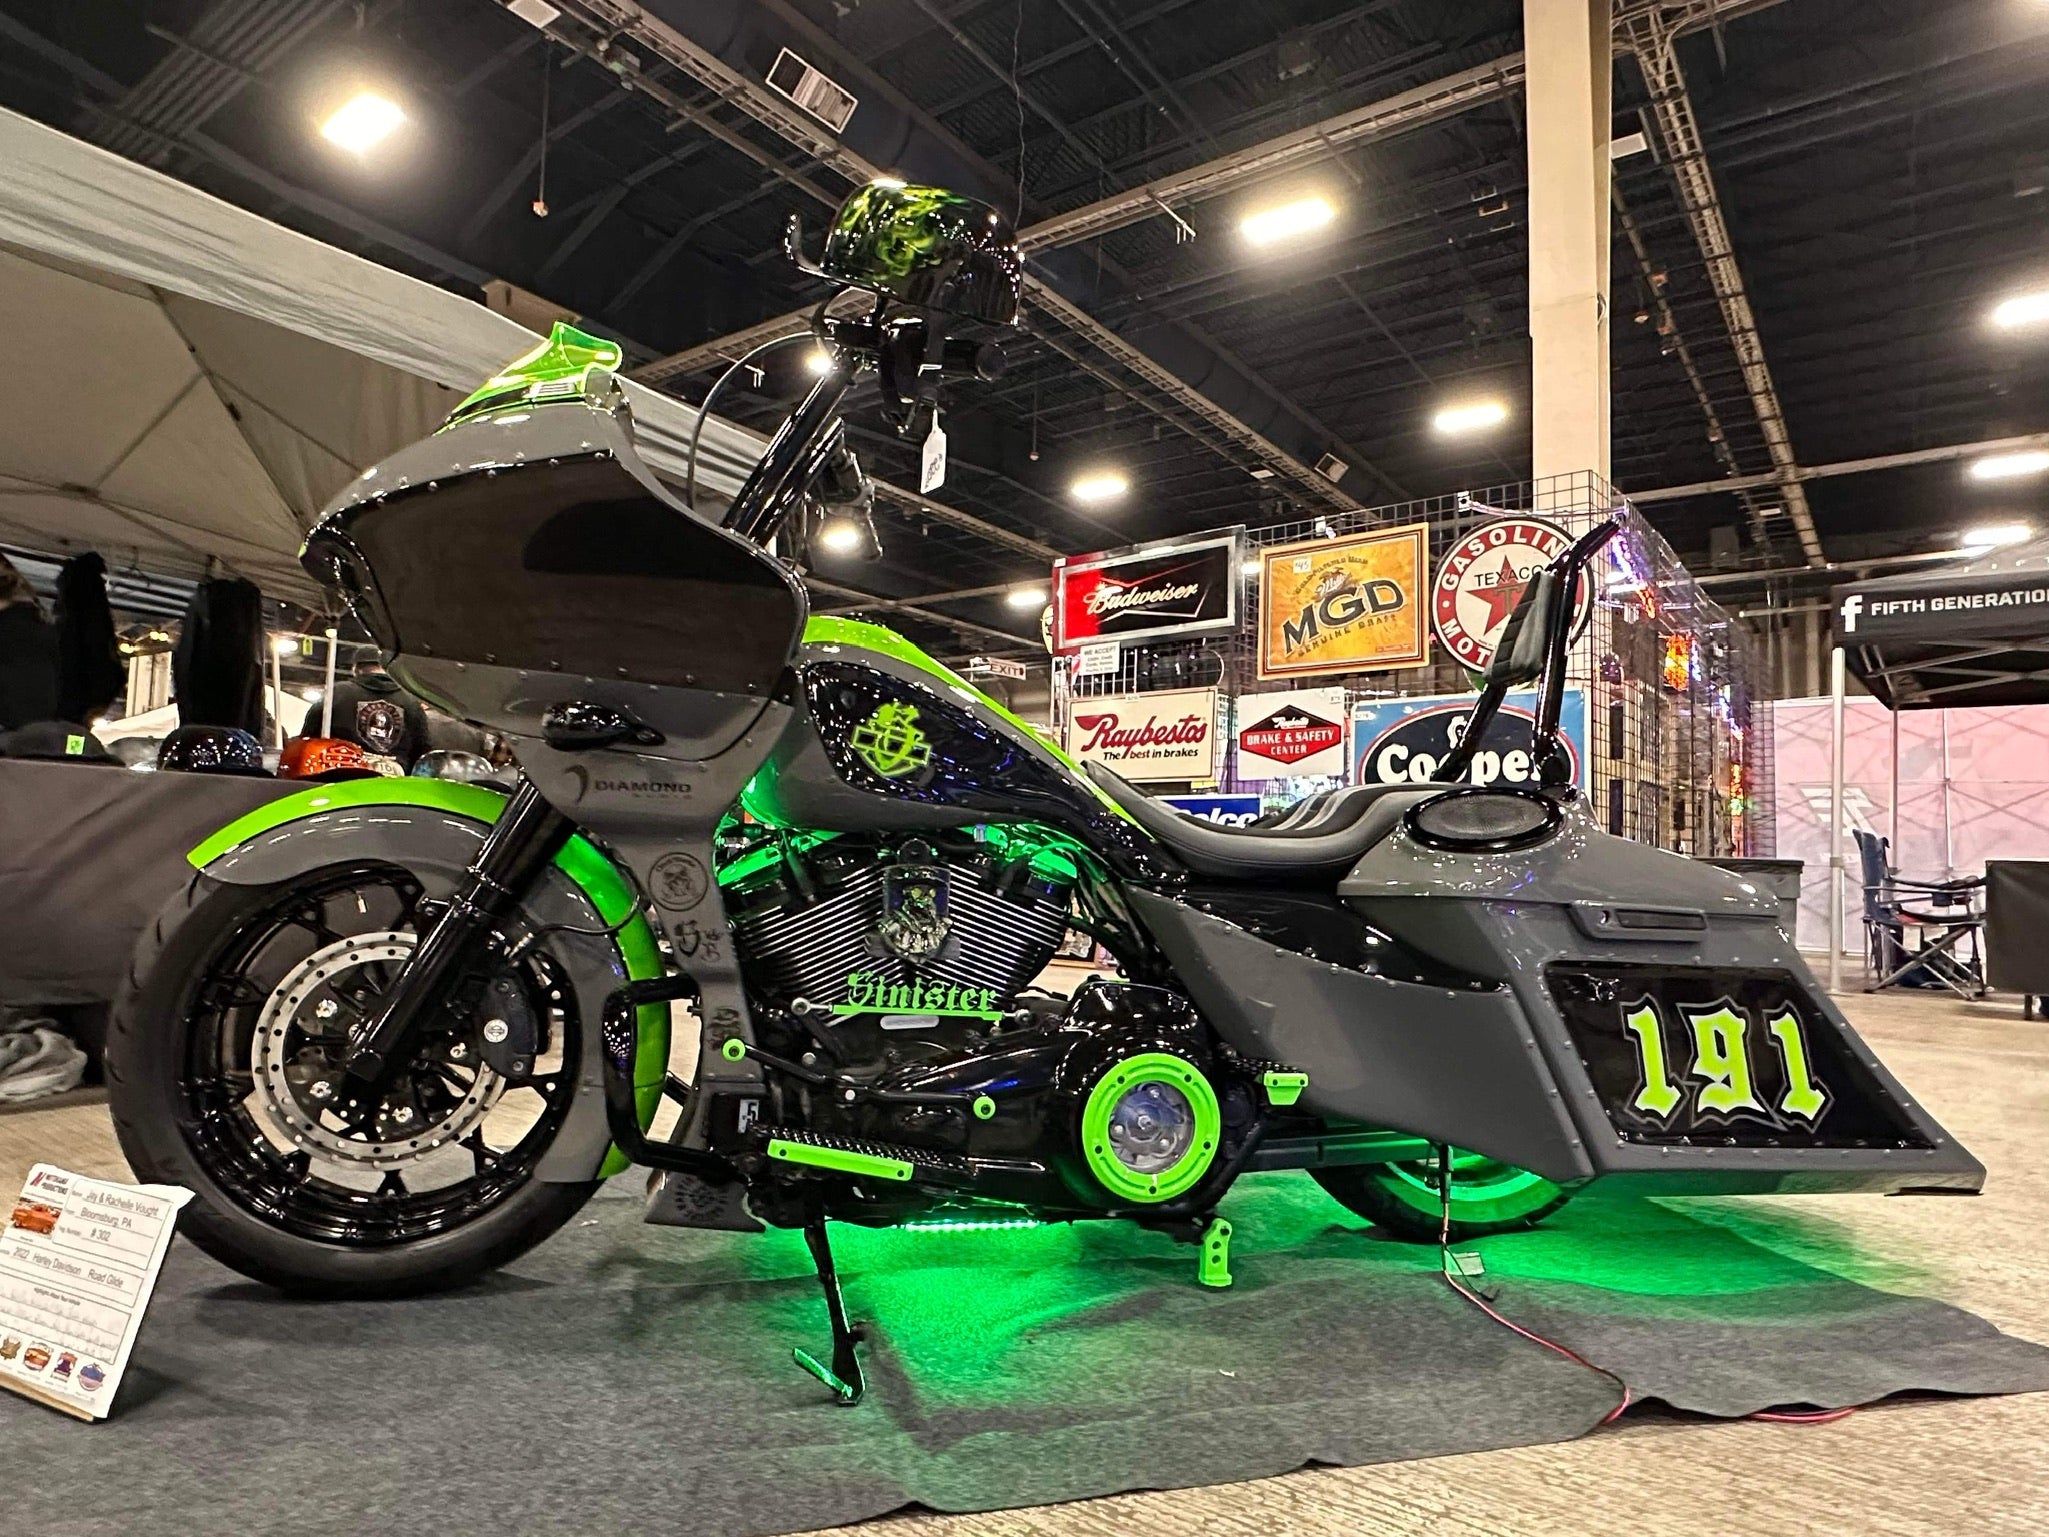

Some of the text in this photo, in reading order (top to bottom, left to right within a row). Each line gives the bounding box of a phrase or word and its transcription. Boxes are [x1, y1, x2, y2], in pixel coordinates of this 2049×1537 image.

[1441, 526, 1566, 591] GASOLIN
[1083, 583, 1199, 616] Budweiser
[1871, 599, 1925, 616] FIFTH
[1282, 579, 1404, 654] MGD
[991, 663, 1019, 676] EXIT
[1074, 713, 1208, 759] Raybestos
[1246, 729, 1334, 746] BRAKE & SAFETY
[1270, 744, 1307, 755] CENTER
[1103, 747, 1199, 761] The best in brakes
[1376, 743, 1541, 788] Cope
[594, 780, 692, 794] DIAMOND
[847, 970, 997, 1012] Sinister
[1620, 994, 1836, 1133] 191
